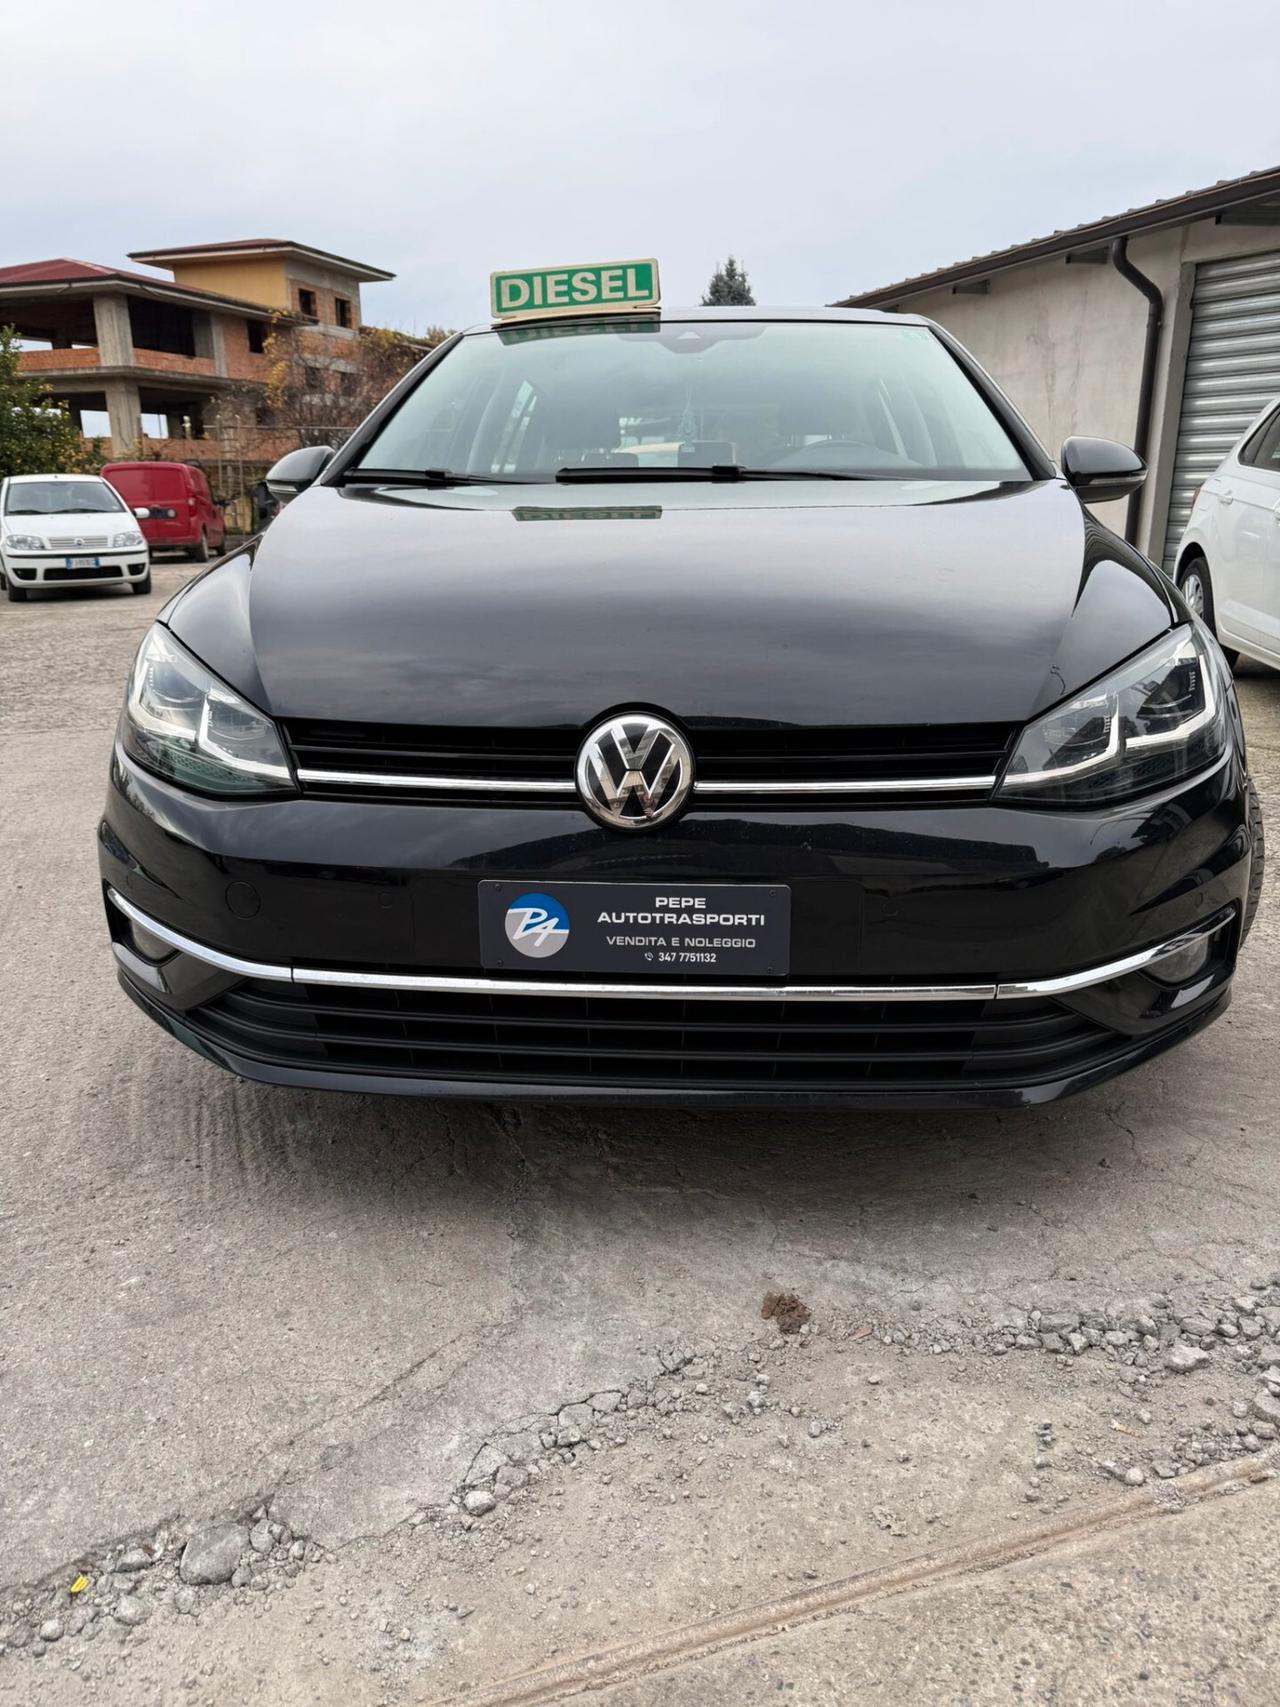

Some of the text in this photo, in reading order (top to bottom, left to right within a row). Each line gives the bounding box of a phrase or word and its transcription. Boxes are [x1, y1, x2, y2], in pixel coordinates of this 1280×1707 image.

[500, 268, 649, 308] DIESEL
[581, 718, 691, 822] VW
[655, 897, 707, 909] PEPE
[597, 912, 765, 926] AUTOTRASPORTI
[606, 935, 756, 949] VENDITA E NOLEGGIO
[658, 952, 717, 963] 347 7751132
